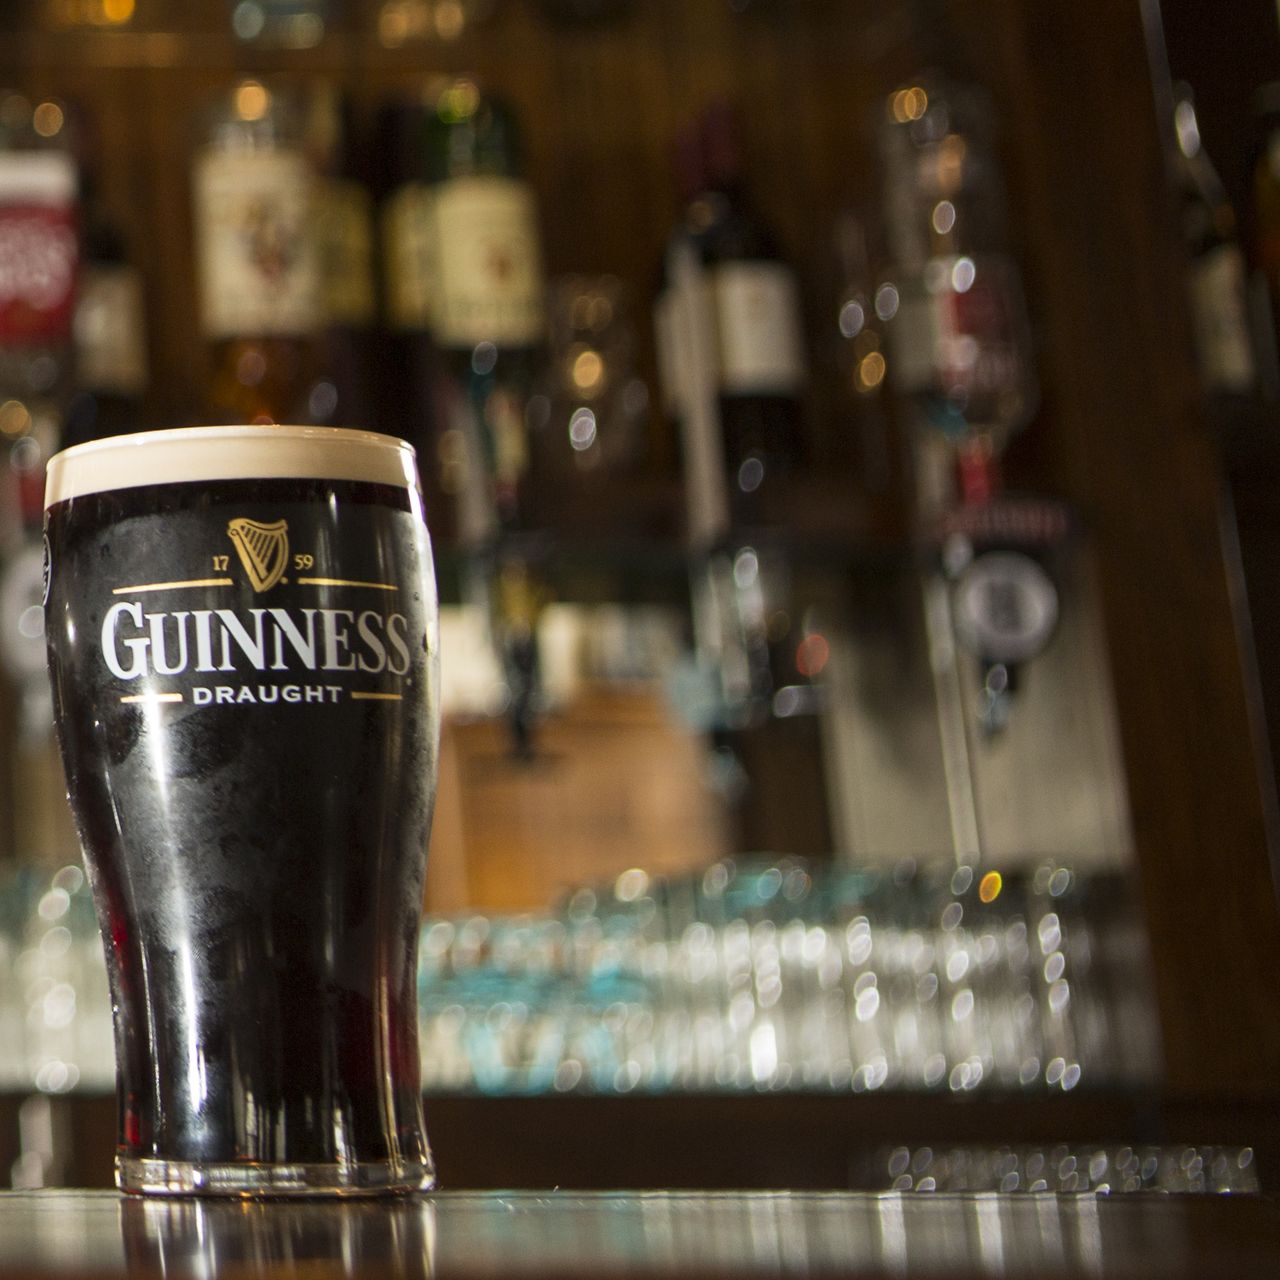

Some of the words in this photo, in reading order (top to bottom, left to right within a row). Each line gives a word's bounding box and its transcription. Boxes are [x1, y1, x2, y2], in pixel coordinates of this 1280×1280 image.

[212, 555, 229, 571] 17
[294, 554, 314, 570] 59
[101, 601, 411, 680] GUINNESS
[192, 685, 343, 705] DRAUGHT
